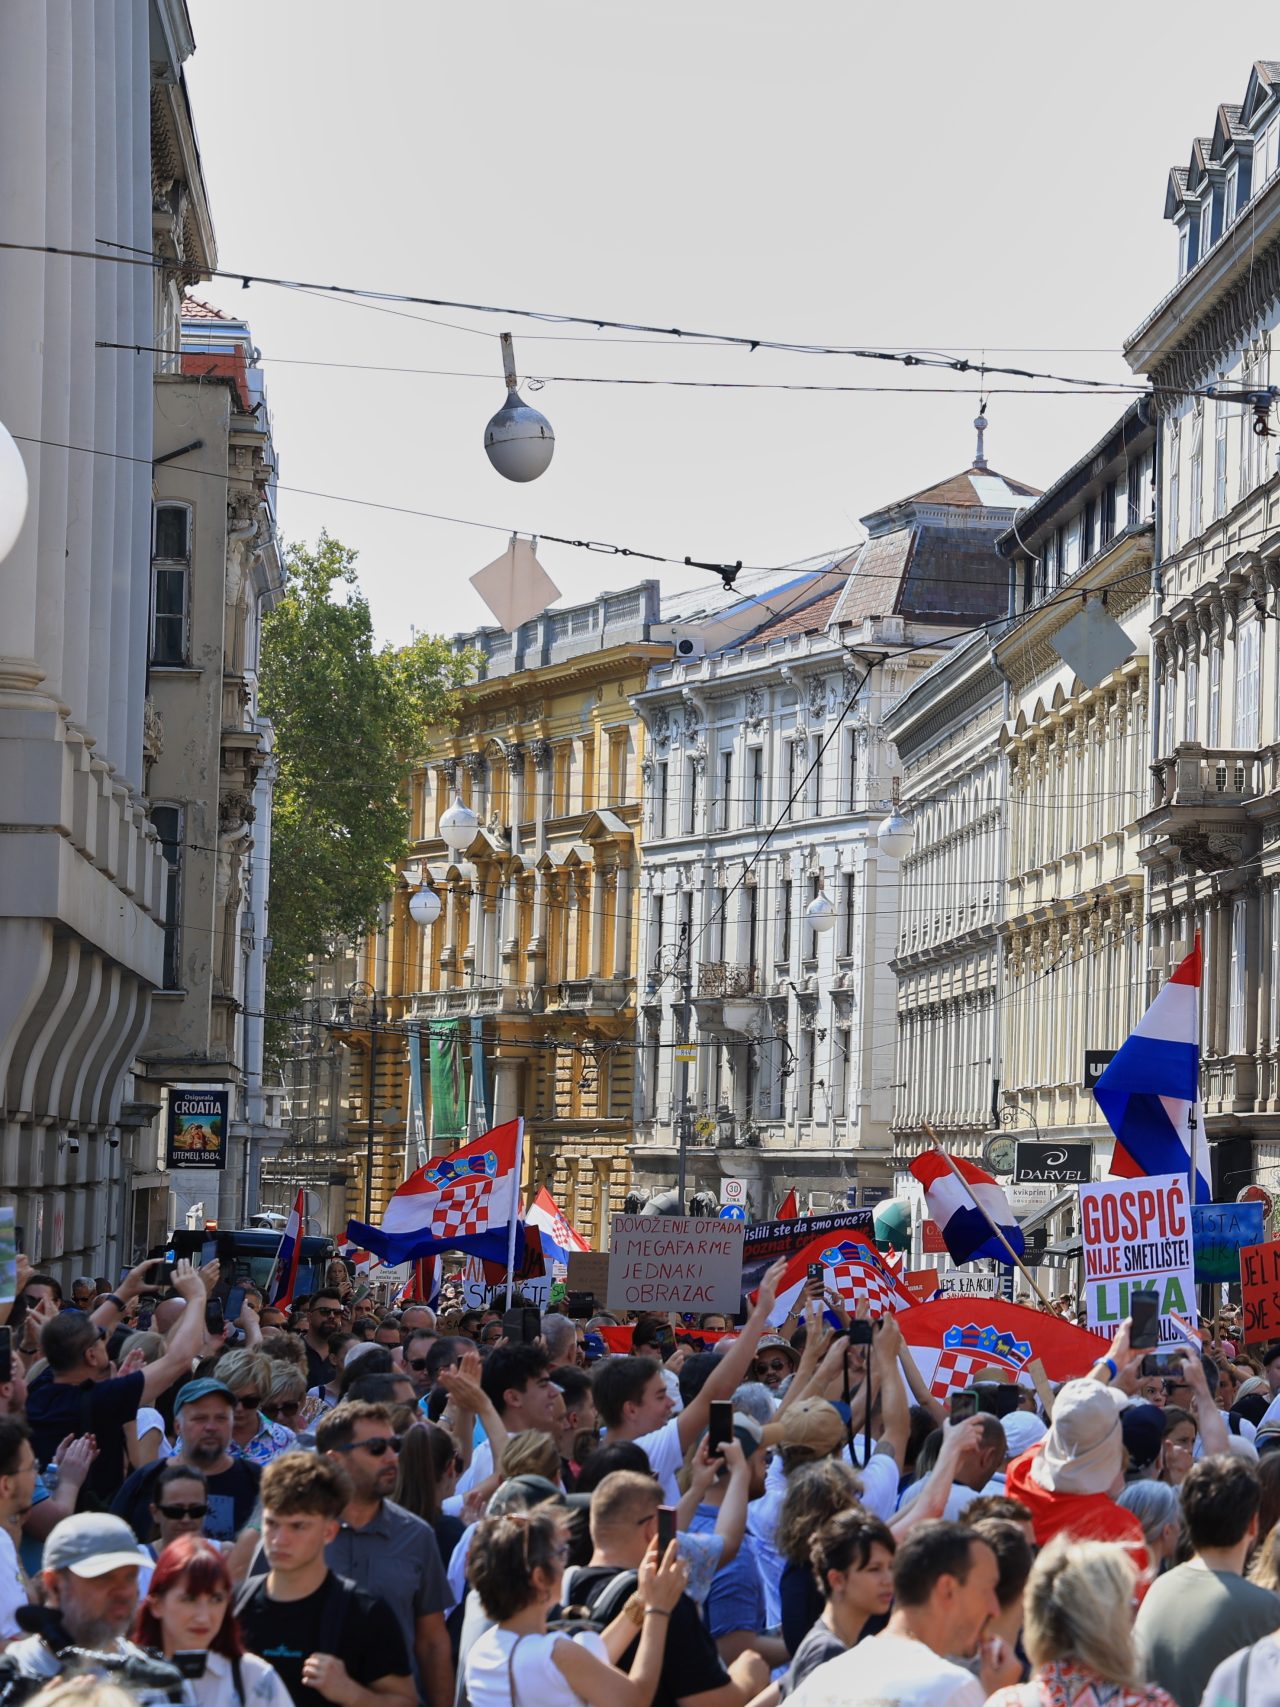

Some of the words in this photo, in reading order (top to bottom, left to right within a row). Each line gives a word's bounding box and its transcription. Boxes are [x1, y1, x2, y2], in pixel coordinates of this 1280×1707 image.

[669, 588, 705, 619] 20
[174, 1101, 222, 1114] CROATIA
[1020, 1169, 1088, 1181] DARVEL
[728, 1185, 739, 1193] 30
[1013, 1188, 1047, 1197] kvikprint
[1082, 1179, 1186, 1246] GOSPIĆ
[615, 1216, 691, 1234] DOVOŽENJE
[695, 1221, 742, 1234] OTPADA
[742, 1226, 769, 1241] islili
[773, 1225, 791, 1237] ste
[793, 1220, 808, 1233] da
[811, 1219, 831, 1231] smo
[834, 1212, 872, 1227] ovce??
[614, 1241, 618, 1254] I
[627, 1240, 732, 1256] MEGAFARME
[1086, 1246, 1122, 1276] NIJE
[1124, 1238, 1190, 1272] SMETLIŠTE!
[622, 1263, 703, 1280] JEDNAKI
[625, 1284, 716, 1303] OBRAZAC
[1244, 1298, 1270, 1331] SVE
